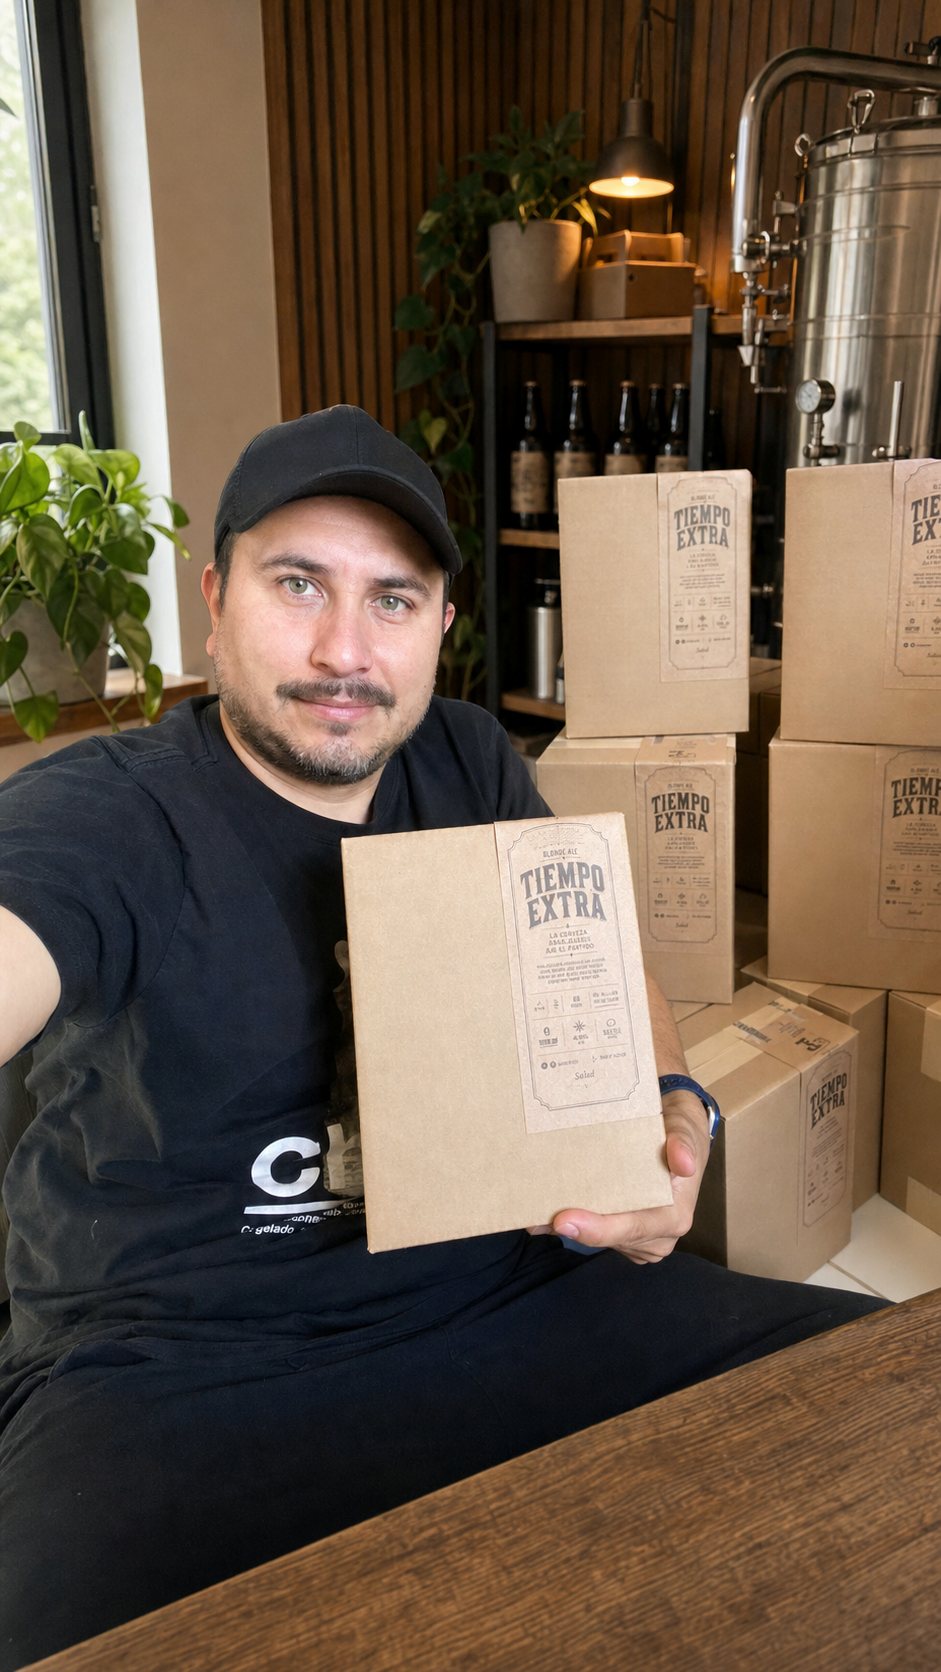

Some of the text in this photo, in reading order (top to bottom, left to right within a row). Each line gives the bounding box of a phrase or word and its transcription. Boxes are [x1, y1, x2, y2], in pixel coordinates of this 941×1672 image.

[674, 504, 731, 531] TIEMPO
[677, 525, 729, 551] EXTRA
[911, 518, 941, 546] EX
[651, 792, 710, 814] TIEMPO
[892, 797, 941, 818] EXTR
[654, 811, 708, 833] EXTRA
[520, 861, 605, 899] TIEMPO
[527, 890, 607, 929] EXTRA
[810, 1072, 848, 1110] TIEMPO
[810, 1090, 845, 1129] EXTRA
[255, 1223, 295, 1235] gelado
